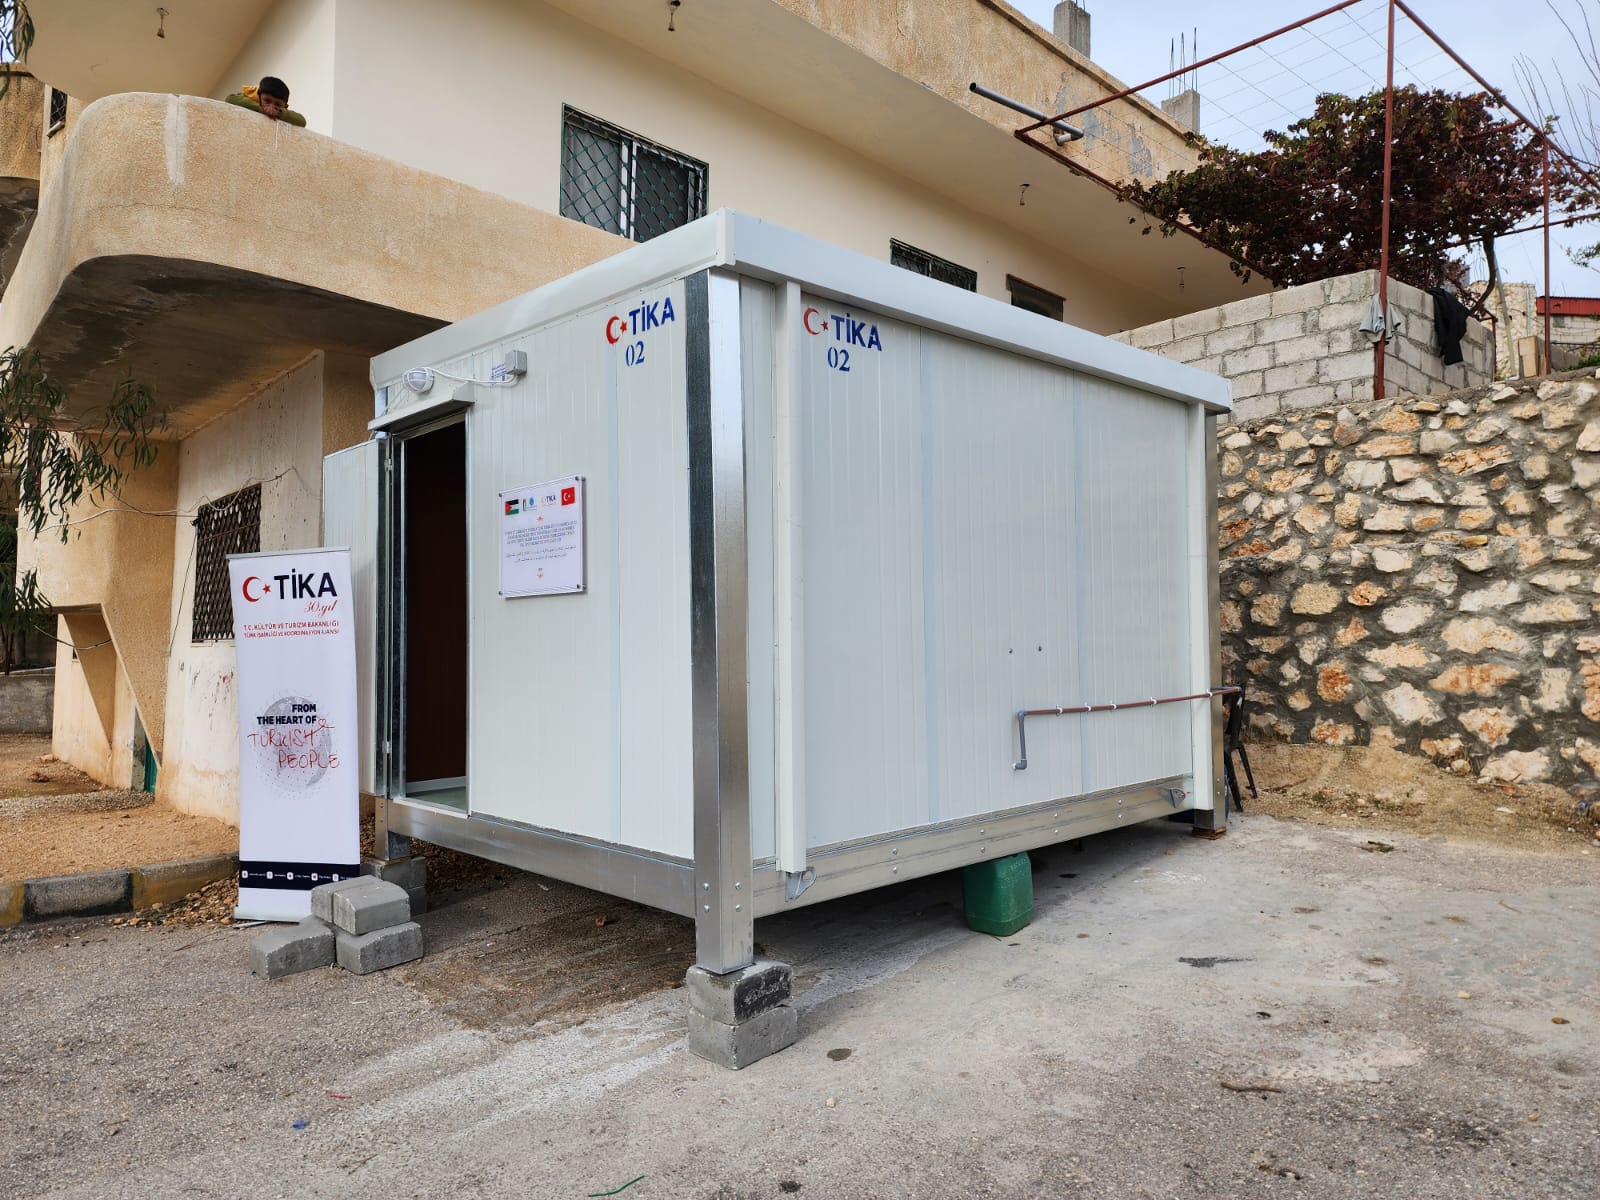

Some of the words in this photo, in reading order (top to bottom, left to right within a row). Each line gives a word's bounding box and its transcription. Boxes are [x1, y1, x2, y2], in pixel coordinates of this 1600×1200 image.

[628, 297, 675, 335] TİKA
[831, 312, 882, 351] TİKA
[625, 340, 645, 367] 02
[827, 346, 851, 372] 02
[274, 568, 338, 600] TİKA
[256, 716, 274, 725] THE
[275, 715, 303, 724] HEART
[305, 715, 317, 724] OF
[292, 704, 316, 713] FROM
[247, 728, 315, 747] TURKISH
[278, 749, 340, 769] PEOPLE
